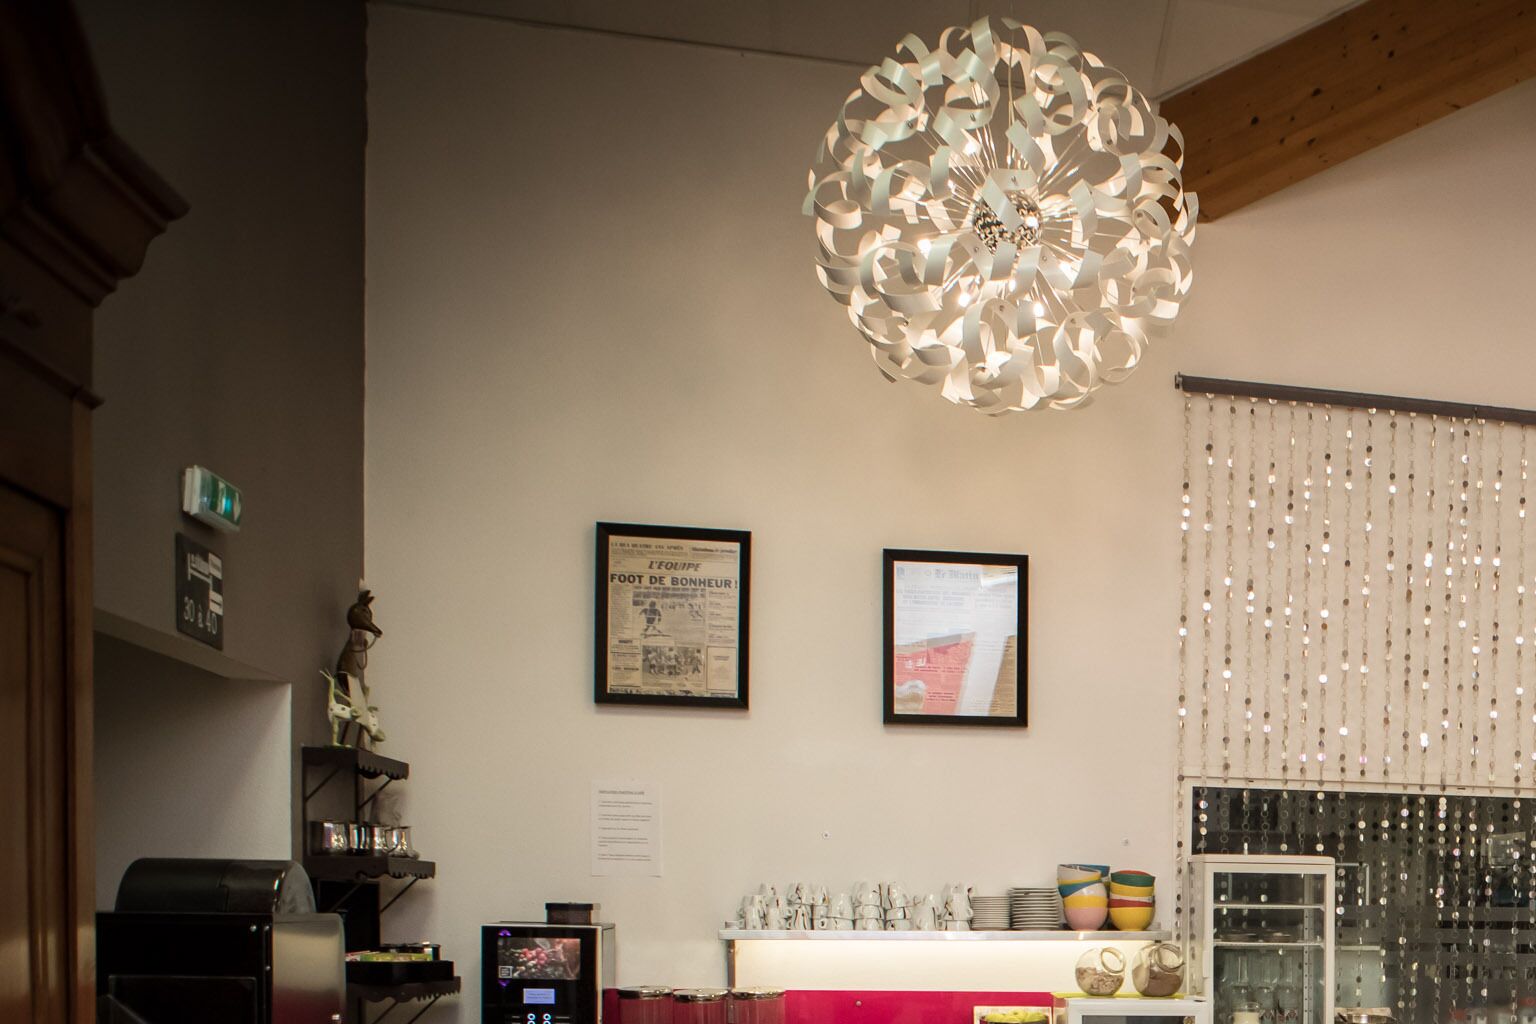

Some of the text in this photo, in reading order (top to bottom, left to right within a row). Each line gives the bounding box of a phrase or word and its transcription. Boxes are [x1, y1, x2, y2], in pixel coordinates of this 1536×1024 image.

[610, 574, 644, 584] FOOT
[649, 575, 666, 585] DE
[671, 576, 732, 589] BONHEUR
[184, 596, 195, 622] 30
[206, 610, 218, 635] 40
